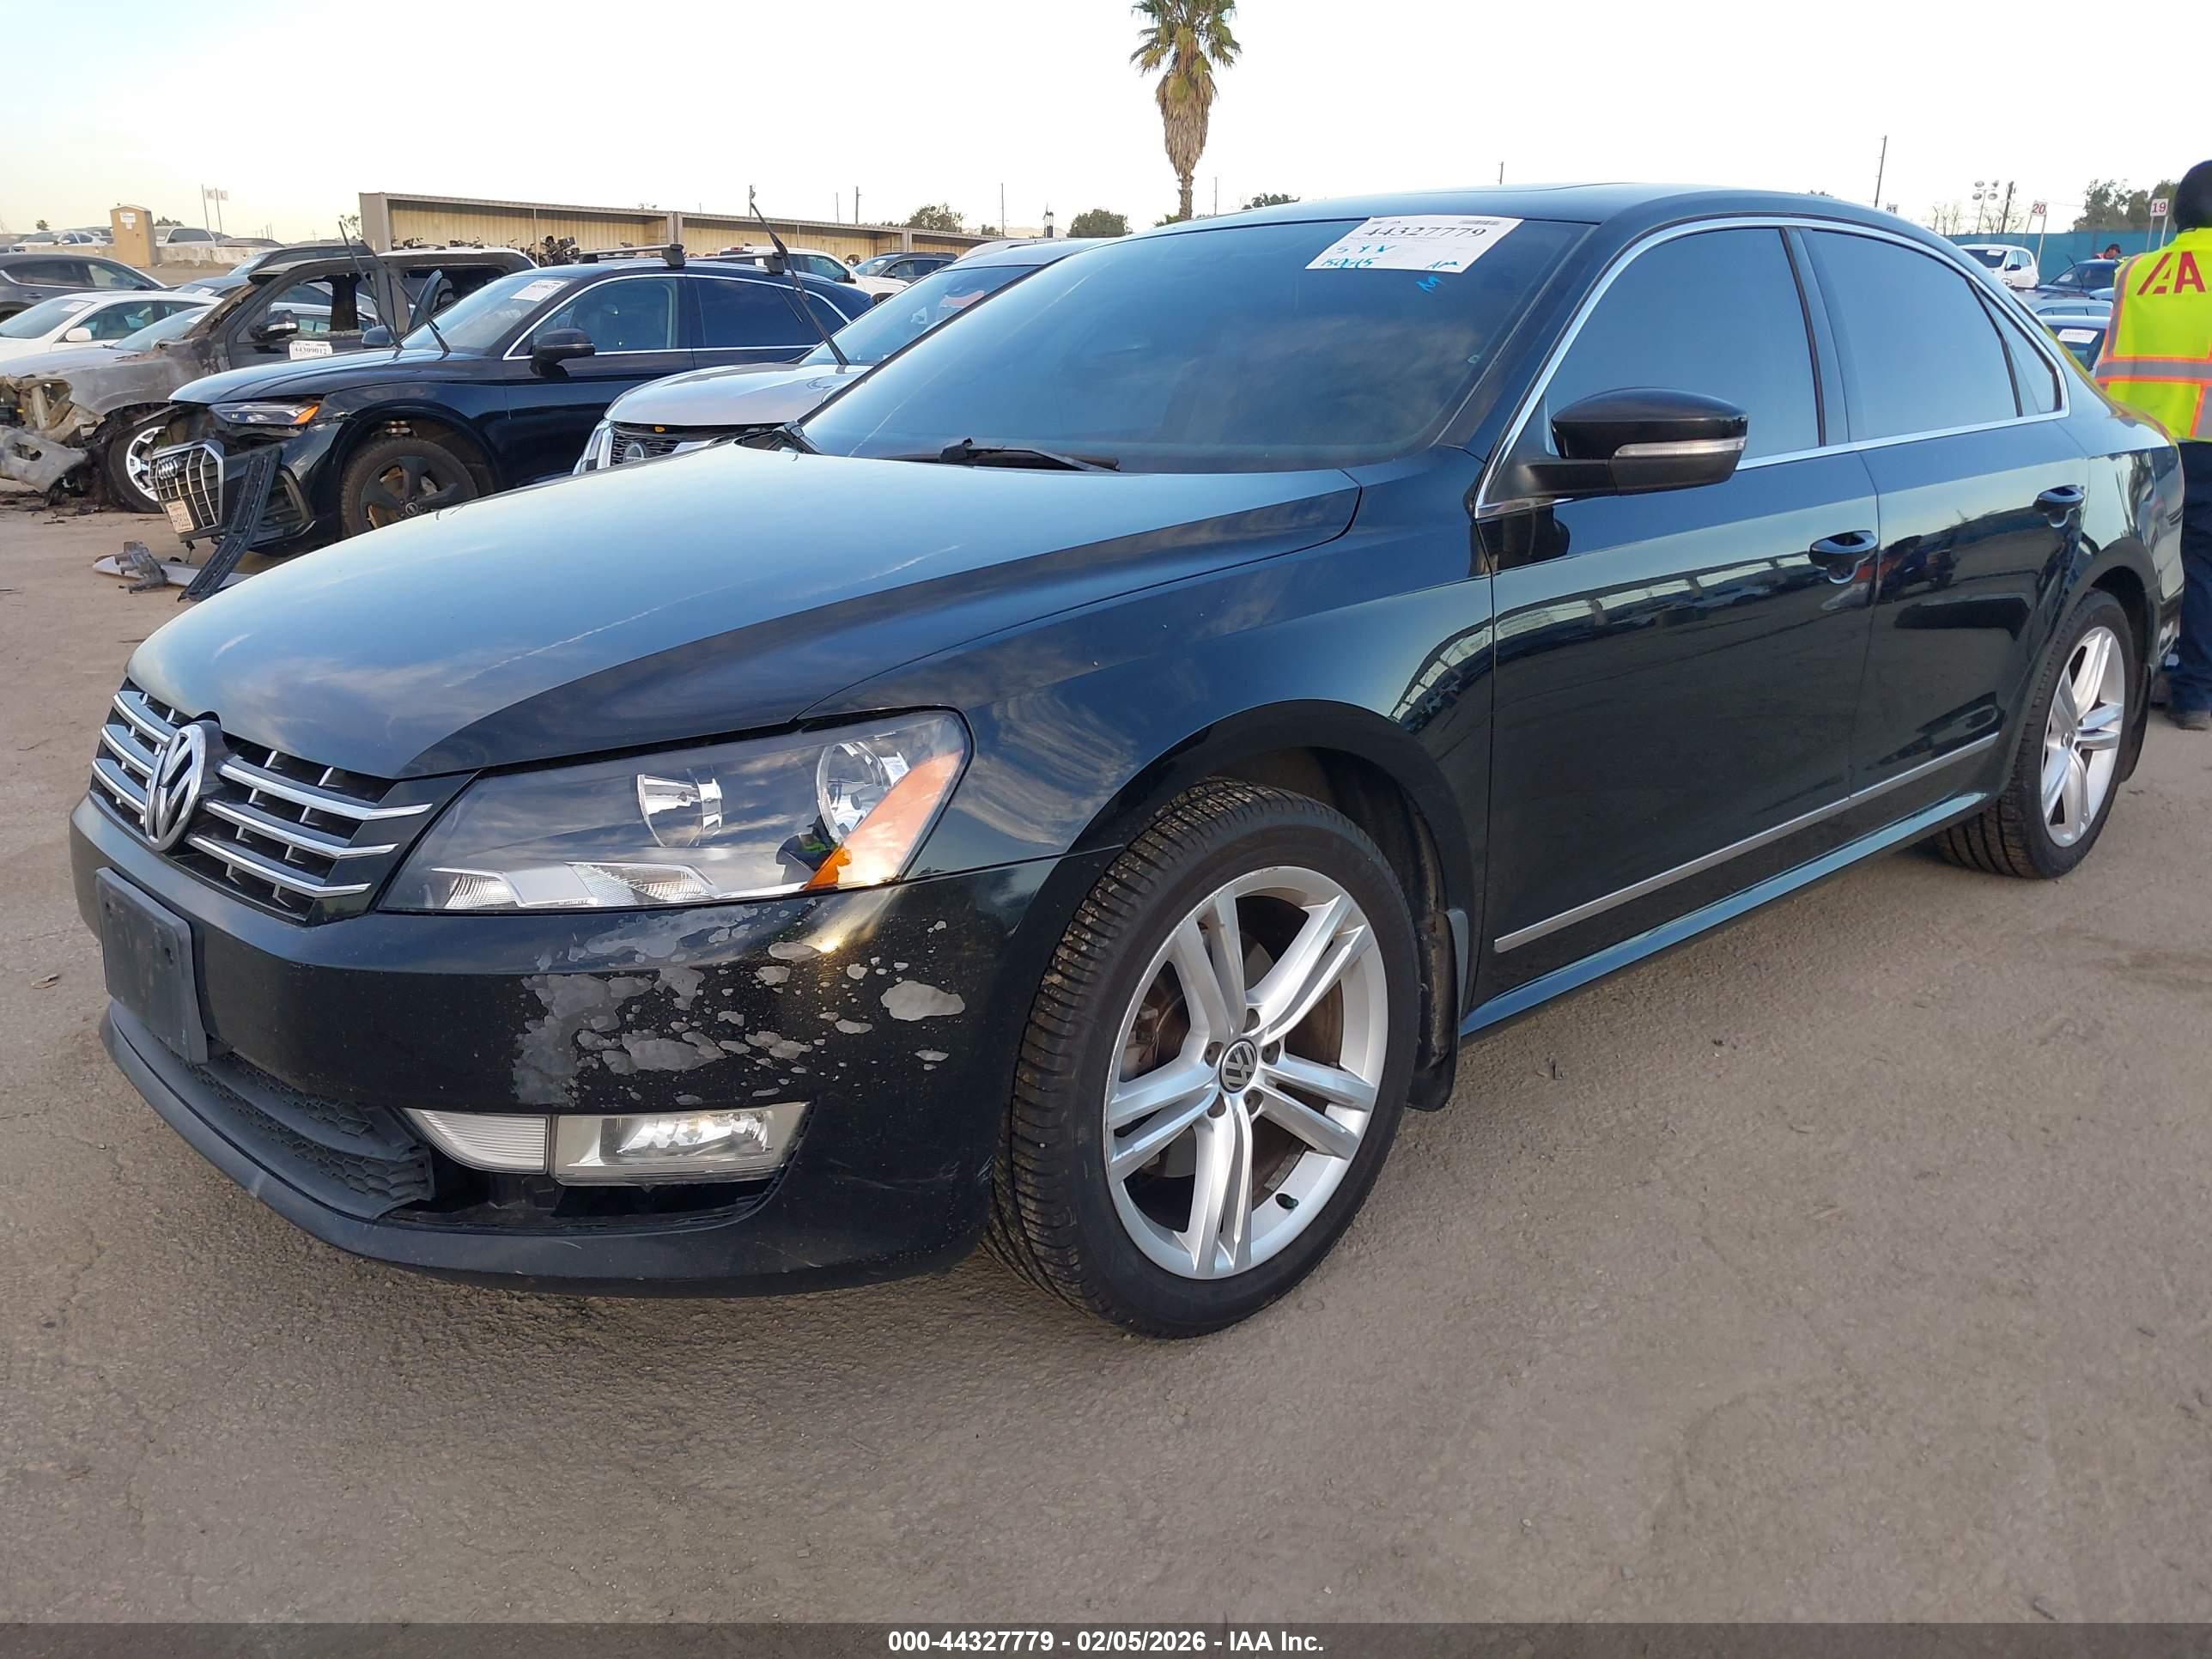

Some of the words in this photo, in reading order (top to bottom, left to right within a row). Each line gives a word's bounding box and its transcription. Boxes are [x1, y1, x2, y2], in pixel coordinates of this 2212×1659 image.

[2032, 203, 2046, 214] 20
[2151, 202, 2166, 213] 19
[1364, 226, 1487, 239] 44327779
